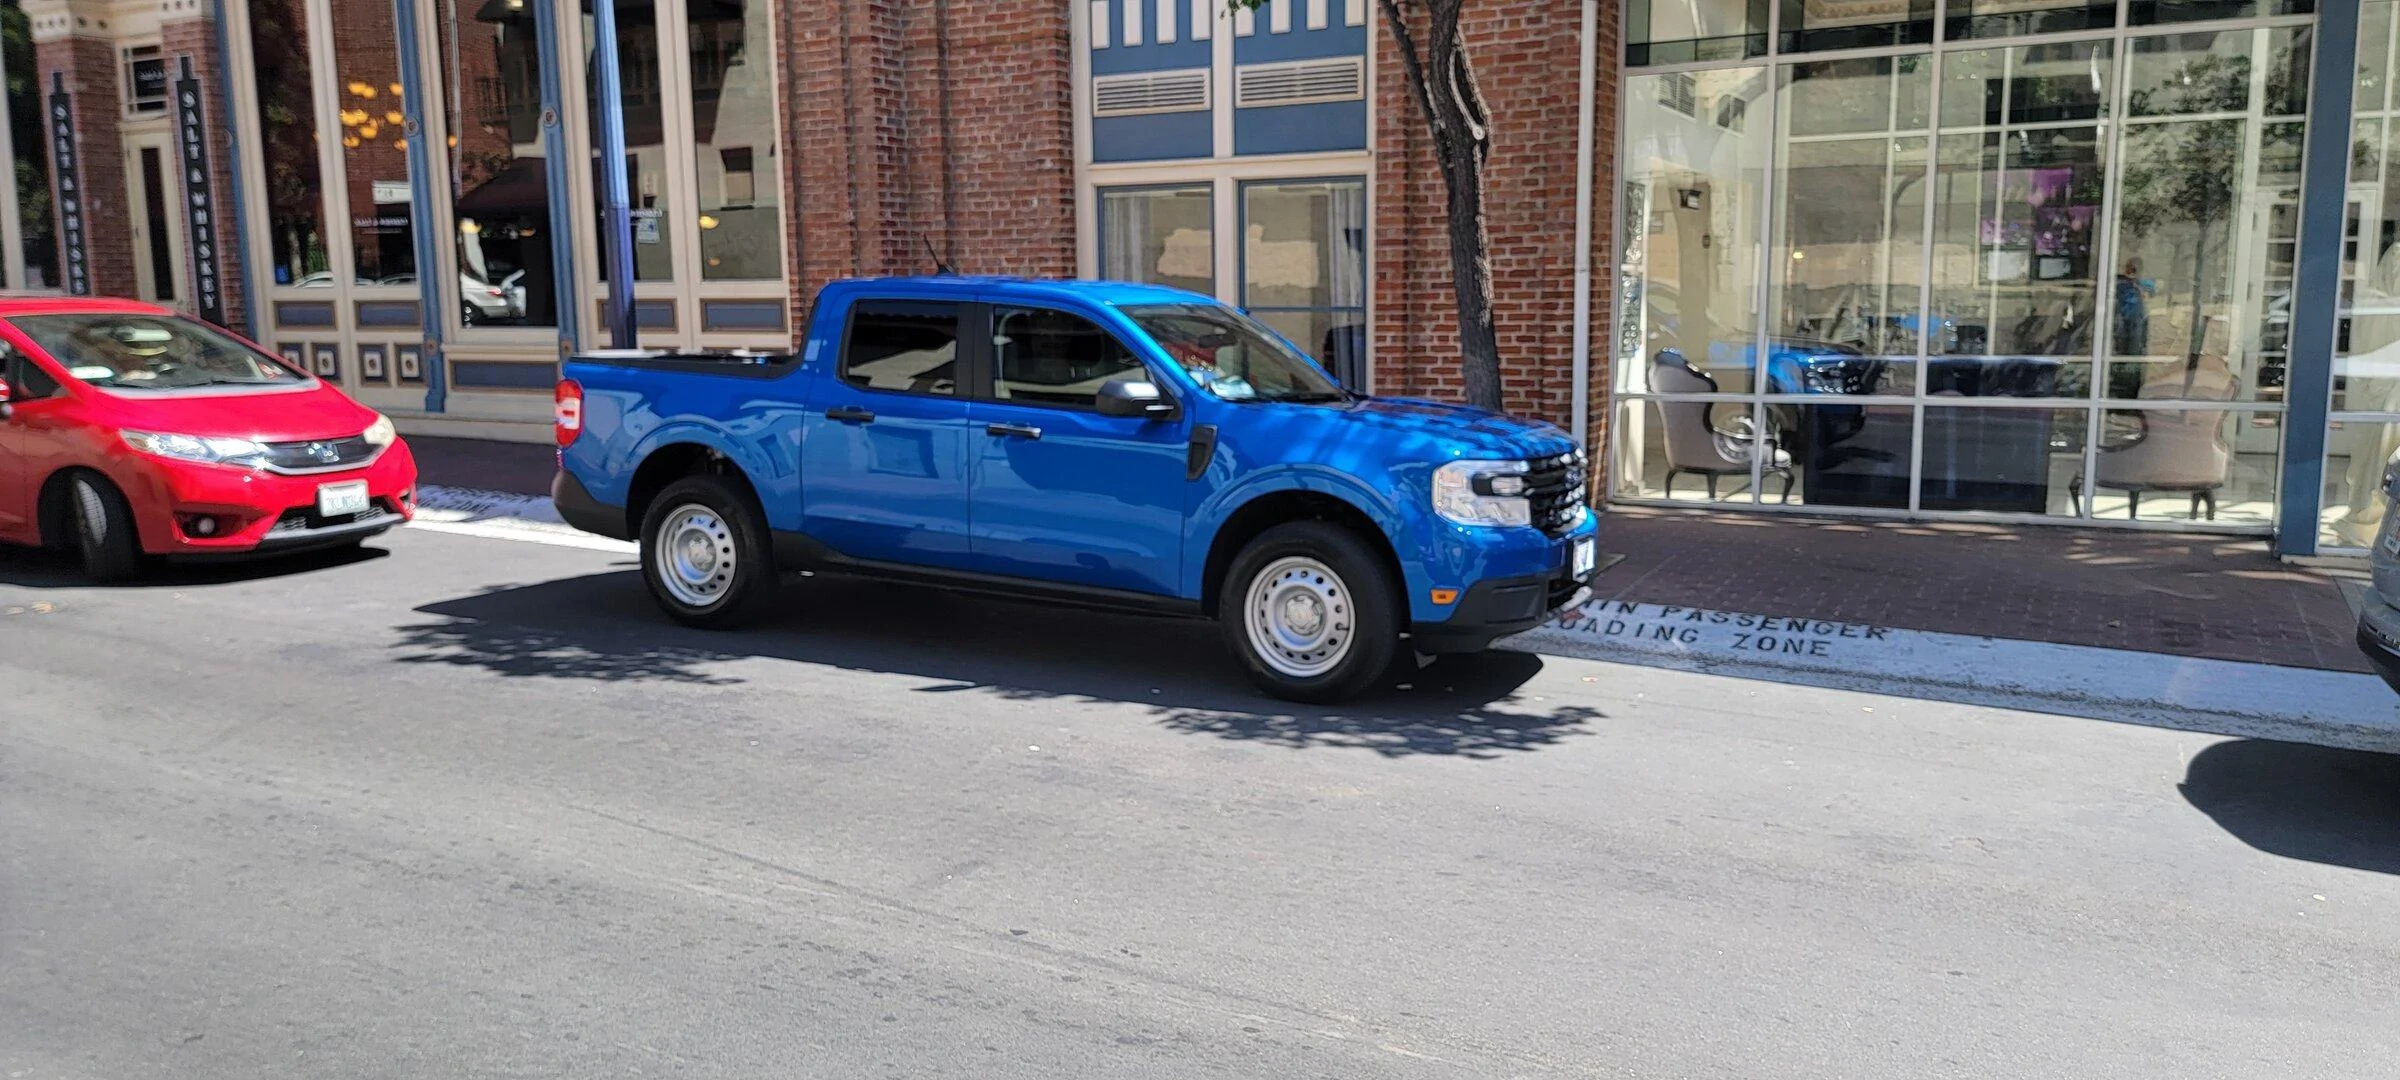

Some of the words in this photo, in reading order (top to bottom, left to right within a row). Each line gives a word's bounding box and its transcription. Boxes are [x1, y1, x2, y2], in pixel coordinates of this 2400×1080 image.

[183, 91, 199, 159] SALT
[192, 192, 215, 310] WHISKEY
[65, 200, 86, 295] WHISKE
[1543, 614, 1700, 644] OADING
[1732, 632, 1833, 657] ZONE
[1660, 605, 1891, 640] PASSENGER
